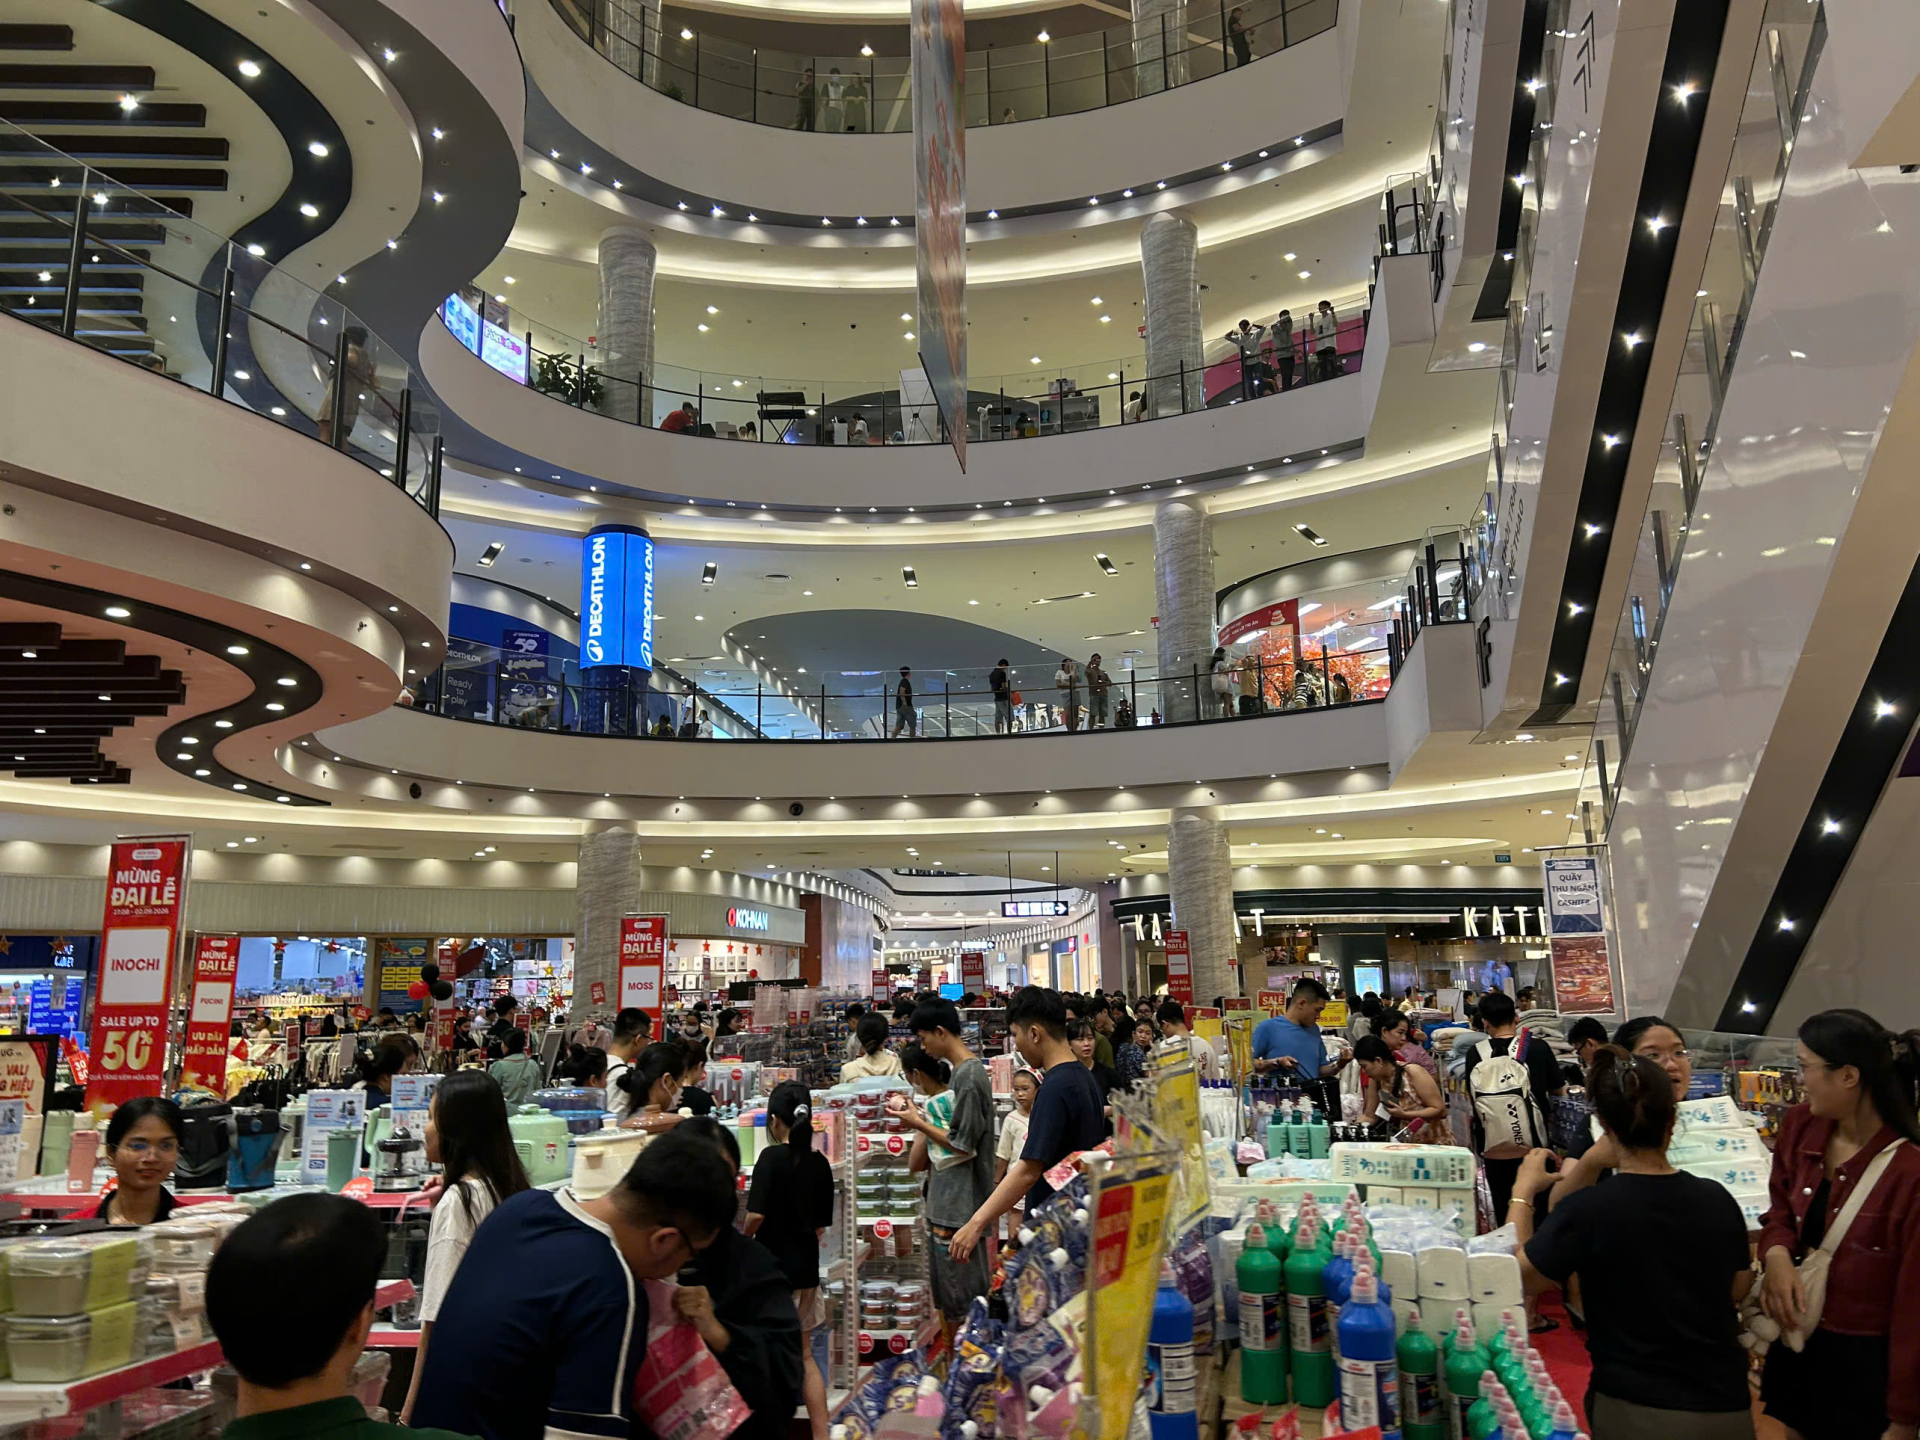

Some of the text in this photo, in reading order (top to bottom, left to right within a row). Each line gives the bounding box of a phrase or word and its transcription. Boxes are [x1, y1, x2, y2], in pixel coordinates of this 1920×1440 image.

[1513, 498, 1524, 551] THAO
[588, 536, 606, 637] DECATHLON
[643, 542, 653, 642] DECATHLON
[446, 650, 482, 663] DECATHLON
[448, 676, 473, 690] Ready
[456, 687, 465, 696] to
[451, 697, 468, 708] play
[116, 867, 161, 884] MỪNG
[1559, 873, 1582, 882] QUẦY
[111, 877, 176, 908] ĐẠI LỄ
[1552, 882, 1595, 893] THU NGÂN
[1558, 899, 1590, 907] CASHIER
[625, 932, 652, 942] MỪNG
[623, 937, 662, 954] ĐẠI LỄ
[201, 950, 227, 960] MỪNG
[111, 958, 160, 971] INOCHI
[198, 956, 235, 972] ĐẠI LỄ
[628, 982, 654, 990] MOSS
[1262, 996, 1284, 1005] SALE
[100, 1016, 160, 1027] SALE UP TO
[101, 1030, 153, 1071] 50%
[7, 1064, 29, 1076] VALI
[76, 1060, 86, 1069] 30
[1511, 1120, 1524, 1147] YONEX
